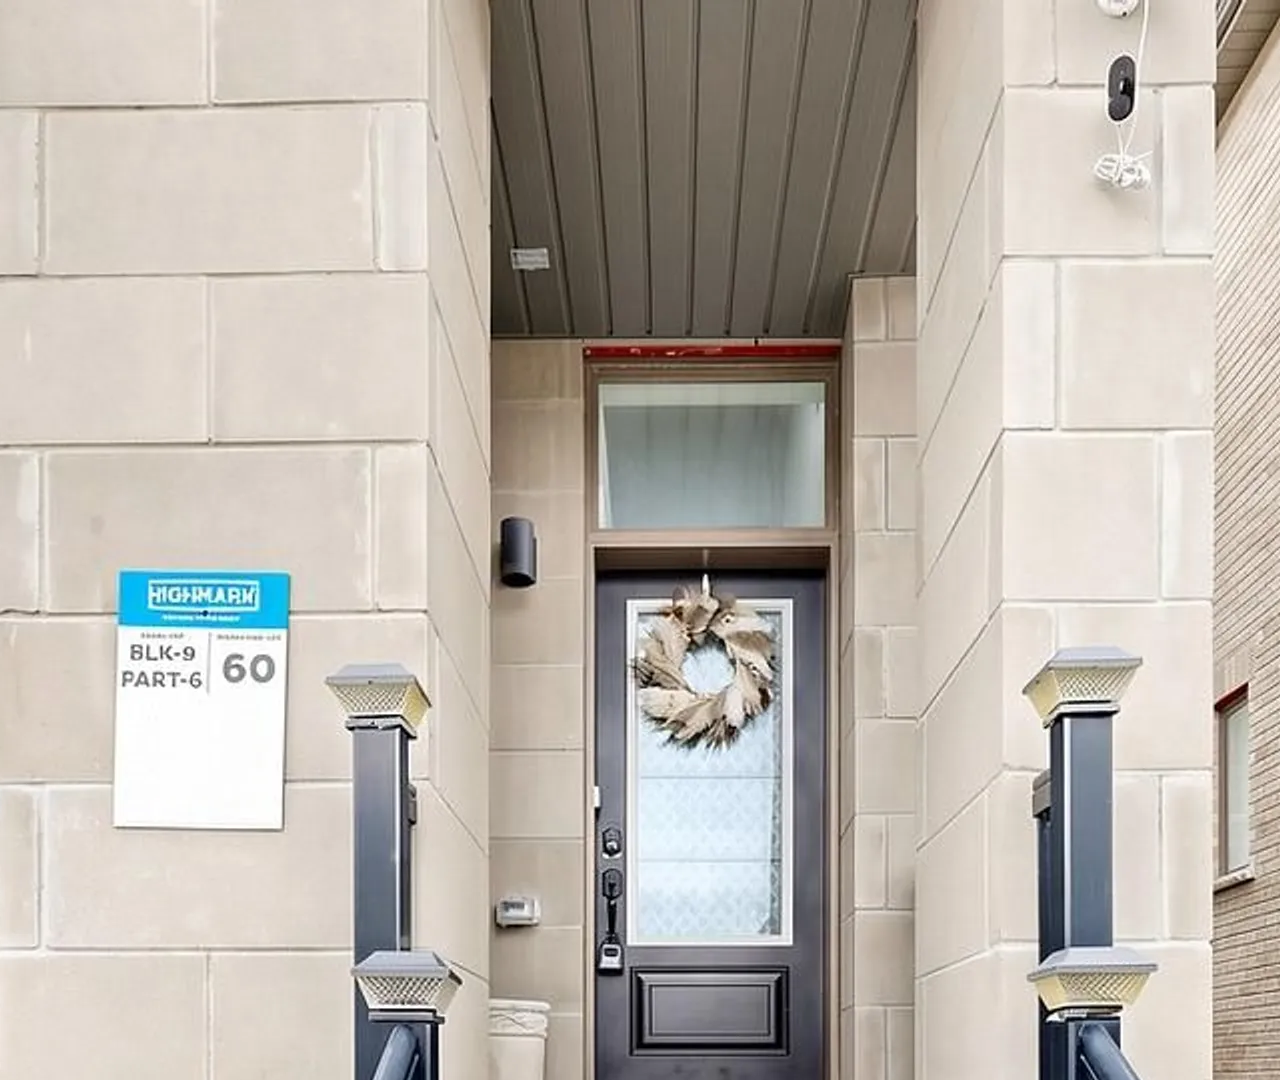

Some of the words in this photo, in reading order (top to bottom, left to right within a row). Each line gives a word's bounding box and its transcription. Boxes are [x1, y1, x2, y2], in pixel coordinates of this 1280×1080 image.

[149, 586, 256, 605] HIGHMARK
[130, 644, 196, 662] BLK-9
[223, 653, 276, 684] 60
[121, 670, 203, 689] PART-6
